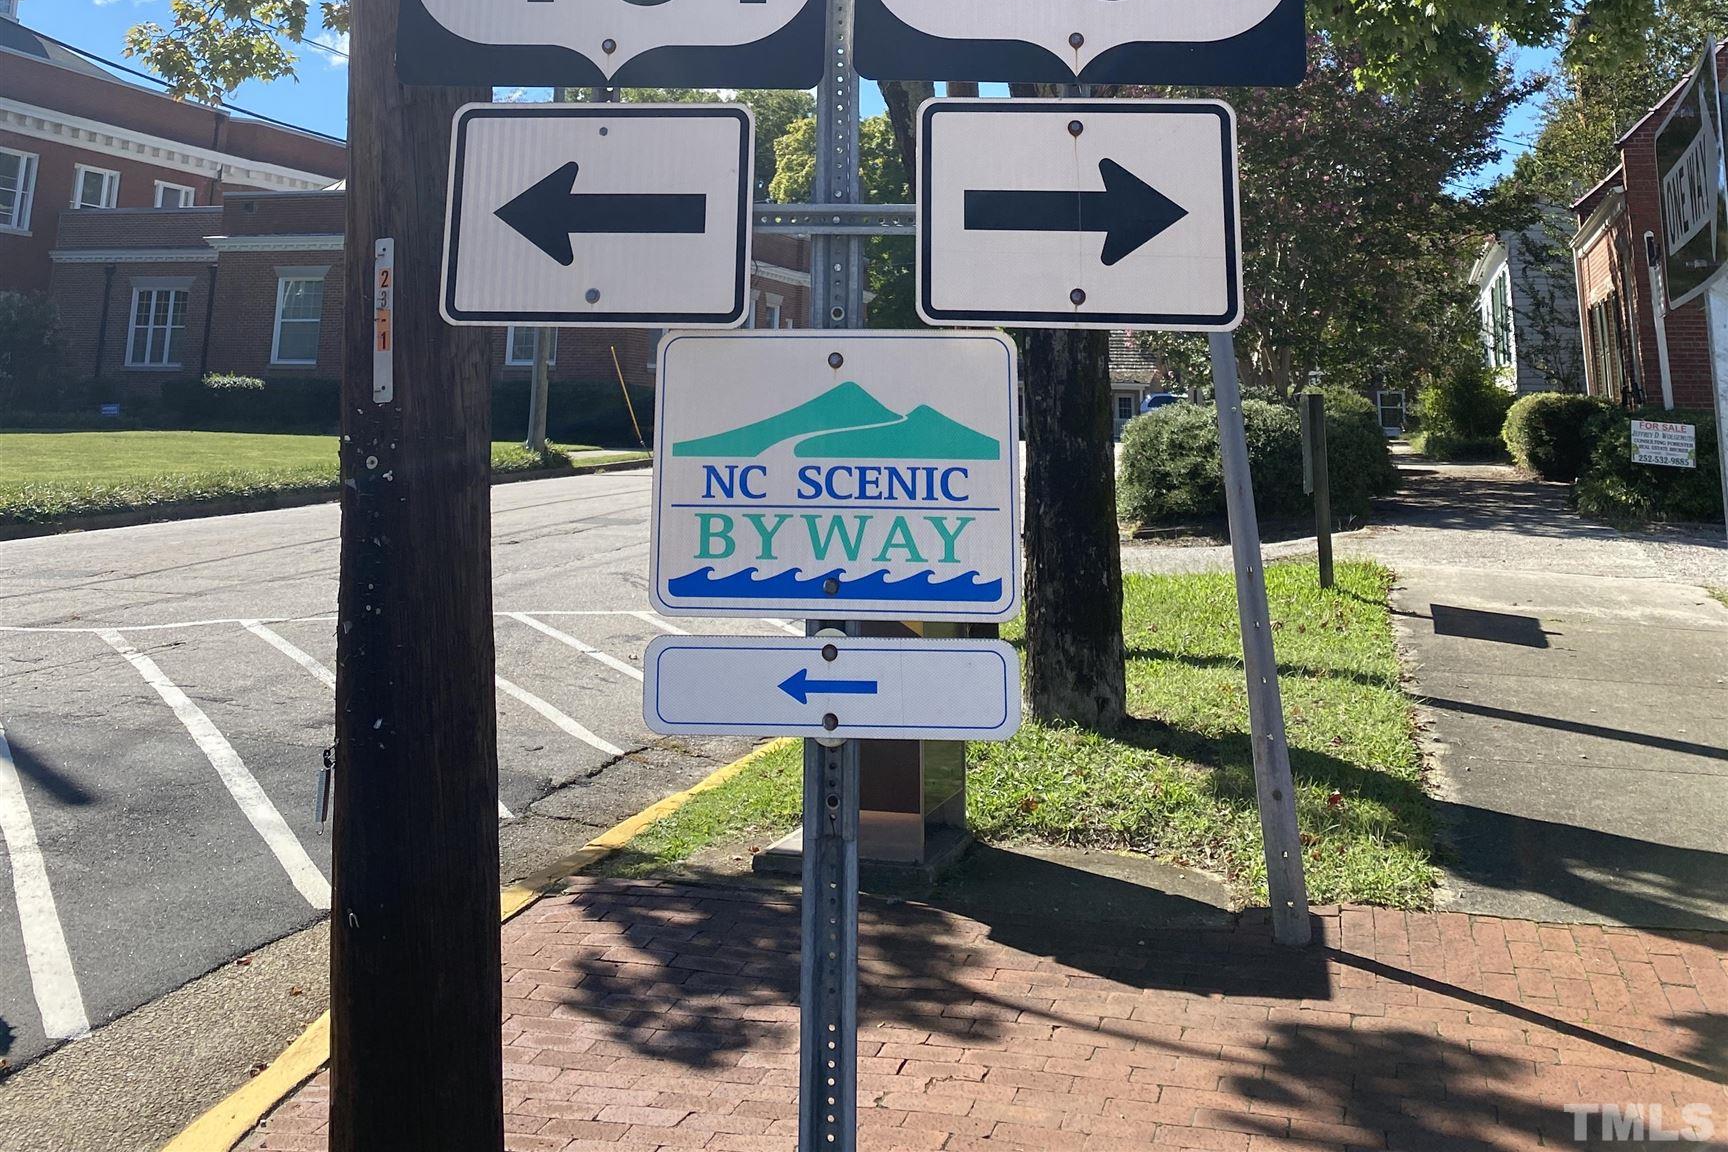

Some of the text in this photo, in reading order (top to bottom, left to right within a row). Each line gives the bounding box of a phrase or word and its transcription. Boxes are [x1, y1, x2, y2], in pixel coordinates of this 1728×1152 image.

[1666, 134, 1710, 245] ONE WAY
[1639, 421, 1687, 433] FOR SALE
[701, 464, 970, 502] NC SCENIC
[693, 512, 977, 564] BYWAY
